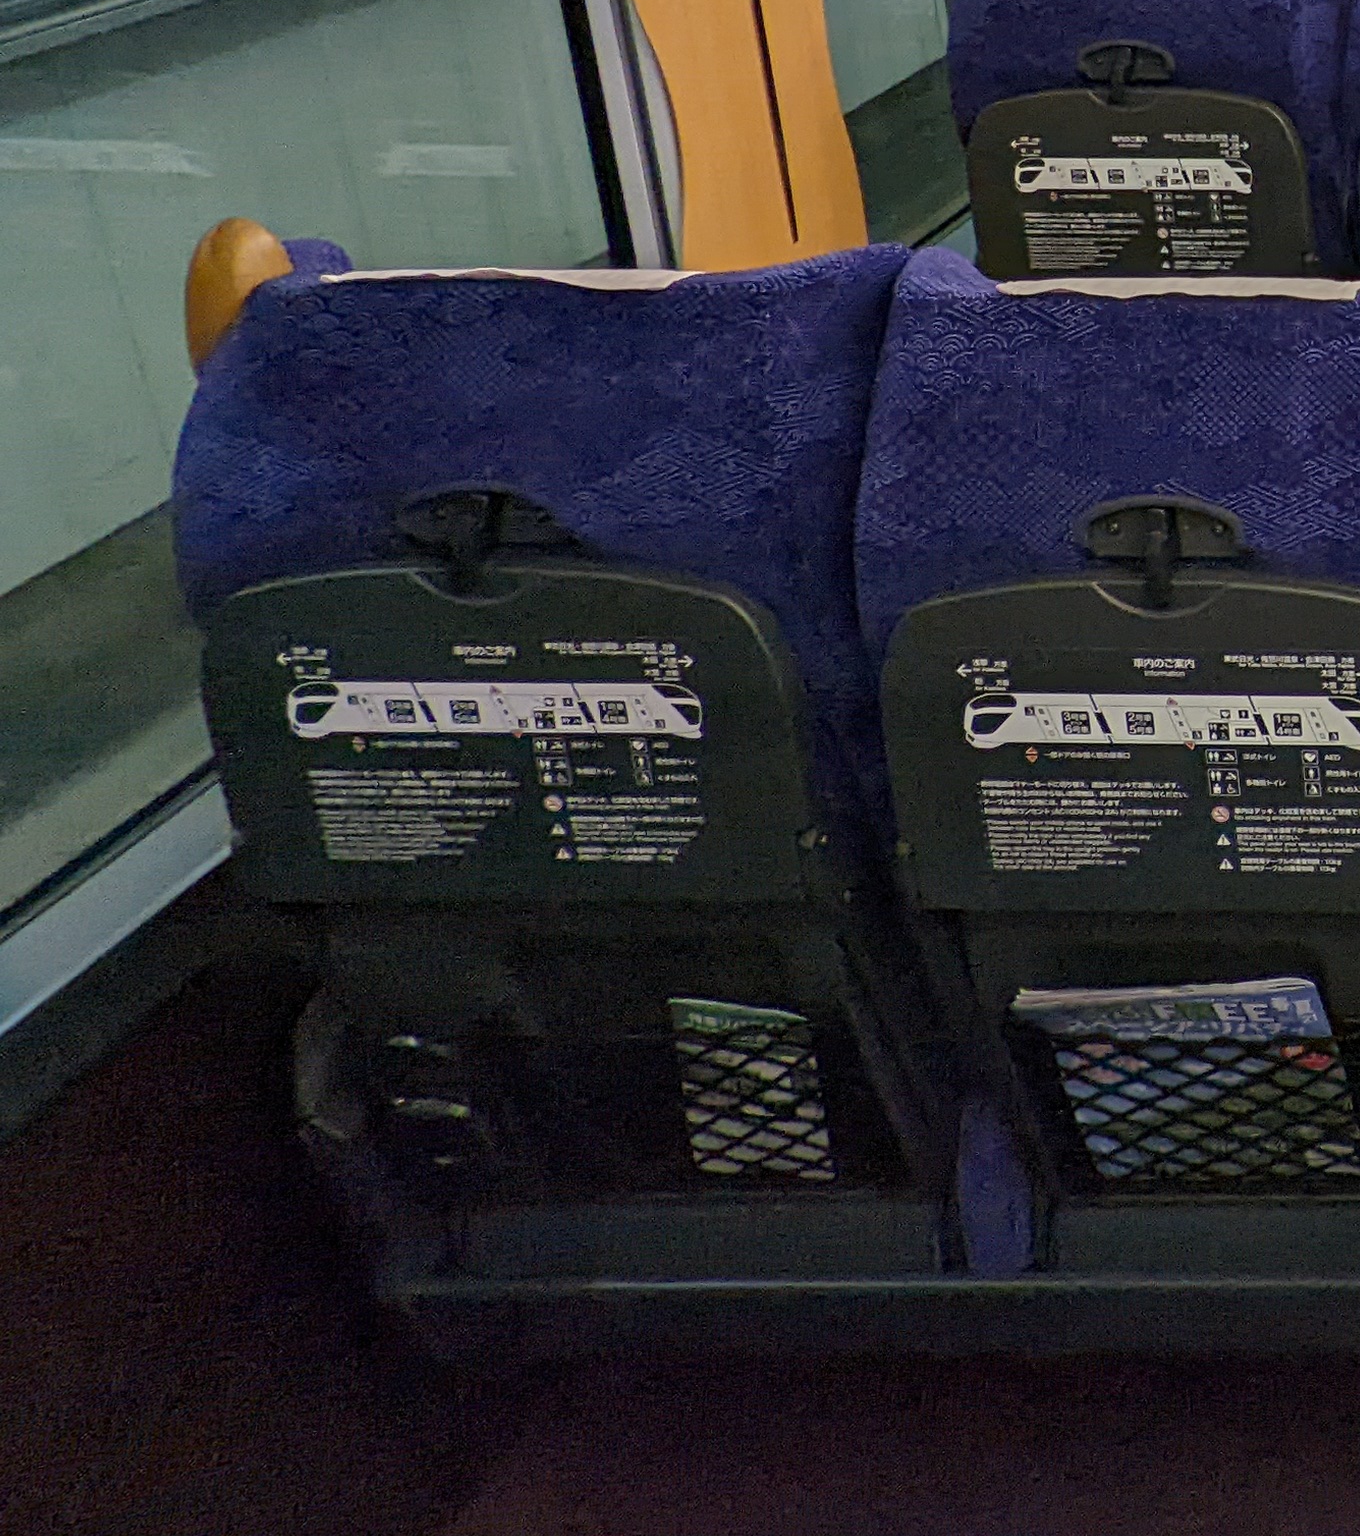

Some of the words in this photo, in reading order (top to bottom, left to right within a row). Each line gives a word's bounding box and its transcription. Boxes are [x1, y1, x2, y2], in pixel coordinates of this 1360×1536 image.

[1132, 658, 1196, 669] 車内のご案内
